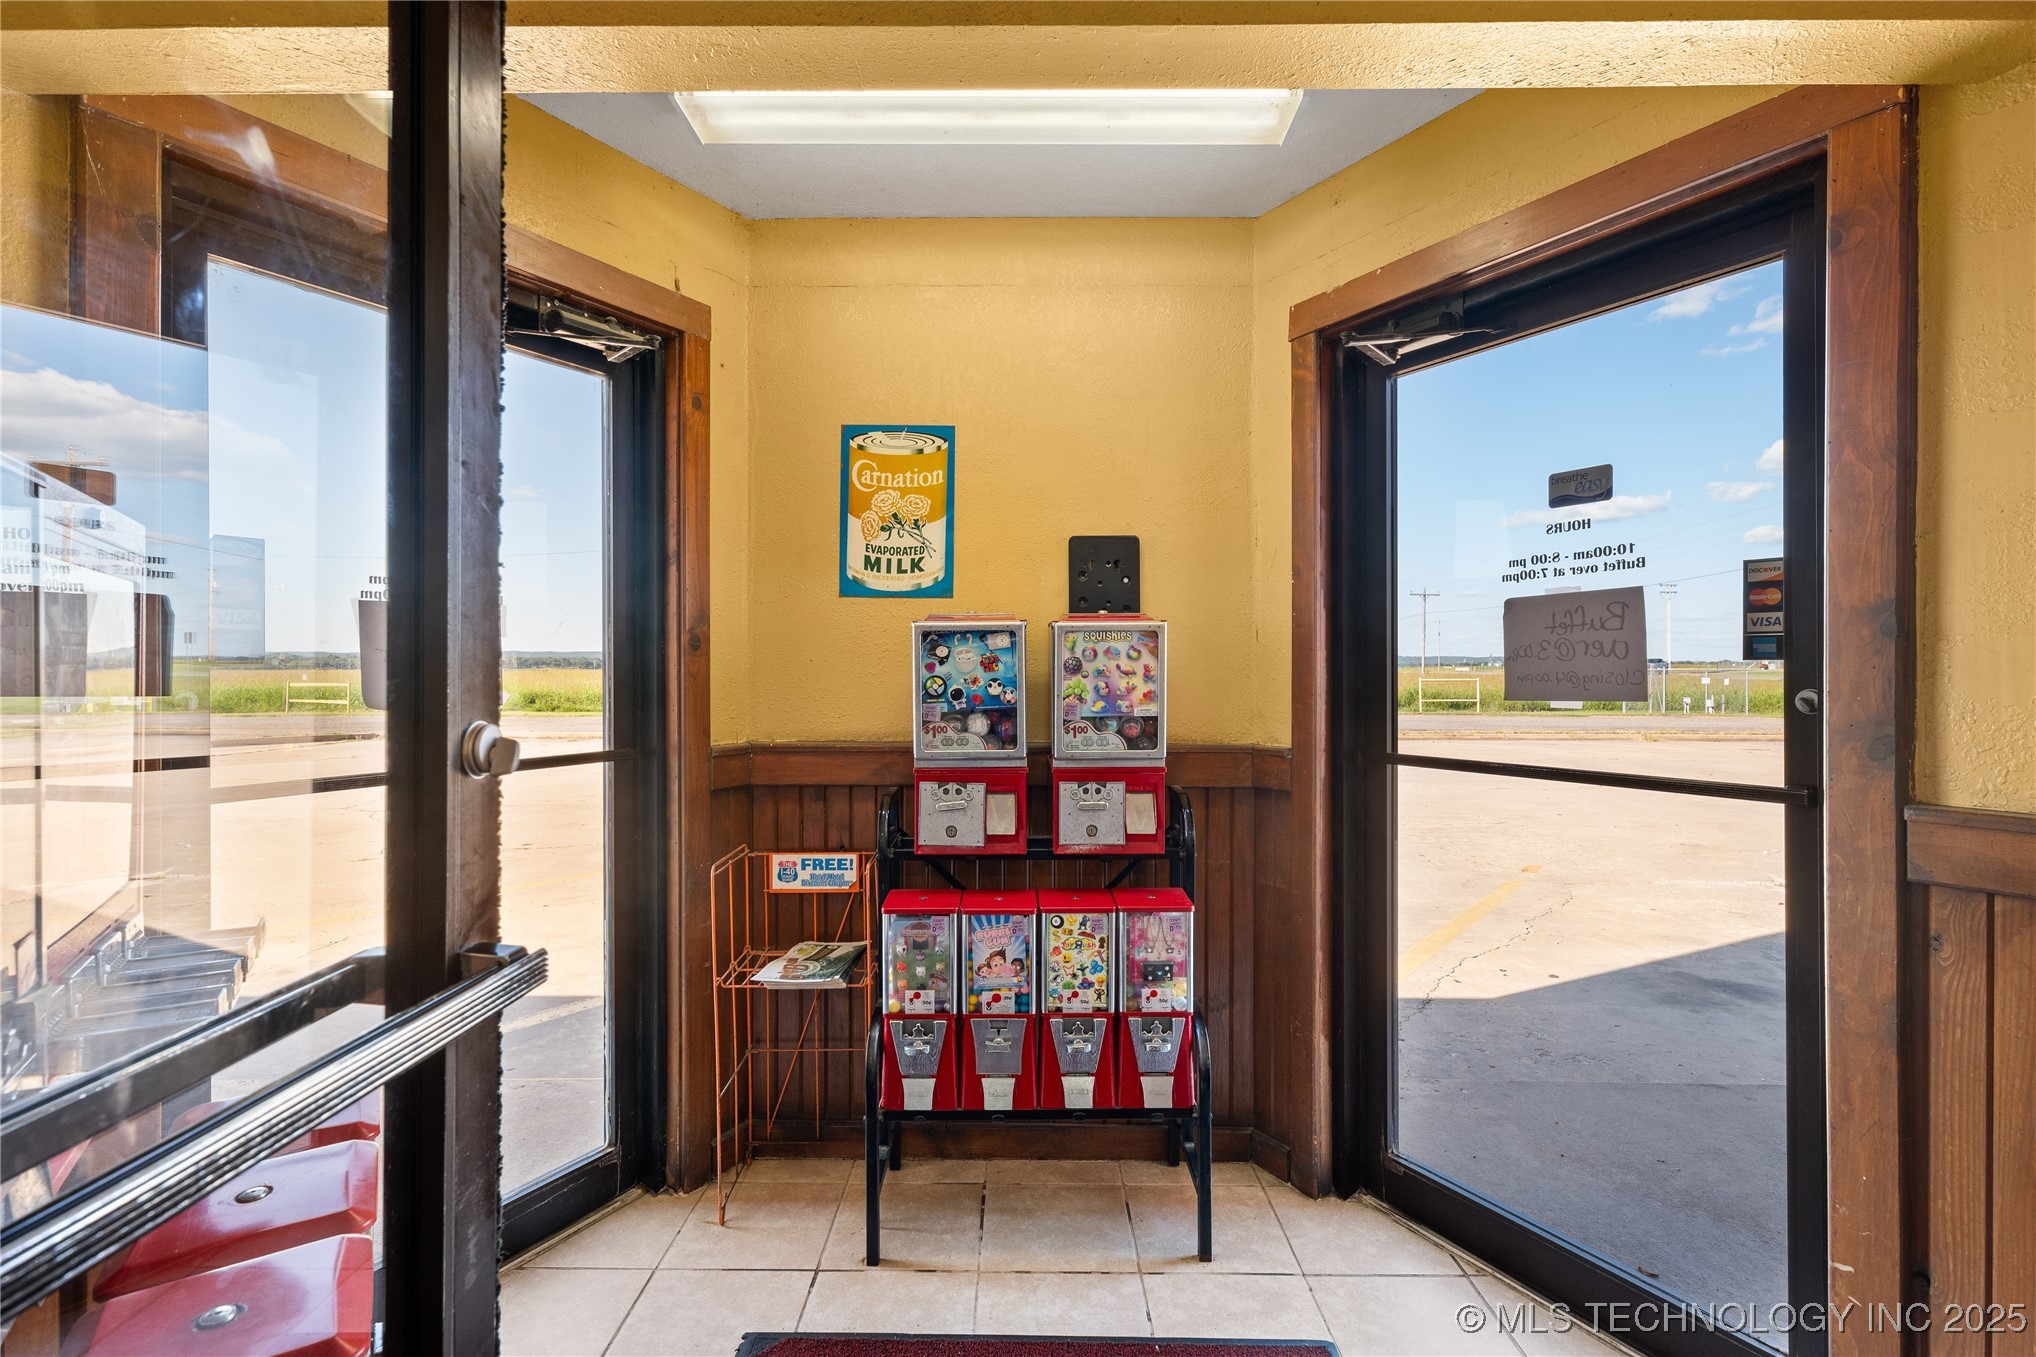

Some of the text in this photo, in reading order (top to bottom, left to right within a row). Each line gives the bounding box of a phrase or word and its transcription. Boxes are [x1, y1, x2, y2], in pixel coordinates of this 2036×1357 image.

[852, 459, 944, 492] Carnation
[1551, 471, 1589, 486] breathe
[1574, 476, 1610, 497] easy
[865, 543, 925, 557] EVAPORATED
[863, 554, 926, 575] MILK
[1749, 566, 1781, 574] DISCOVER
[1749, 593, 1781, 601] MasterCard
[1750, 616, 1782, 627] VISA
[801, 858, 854, 871] FREE!
